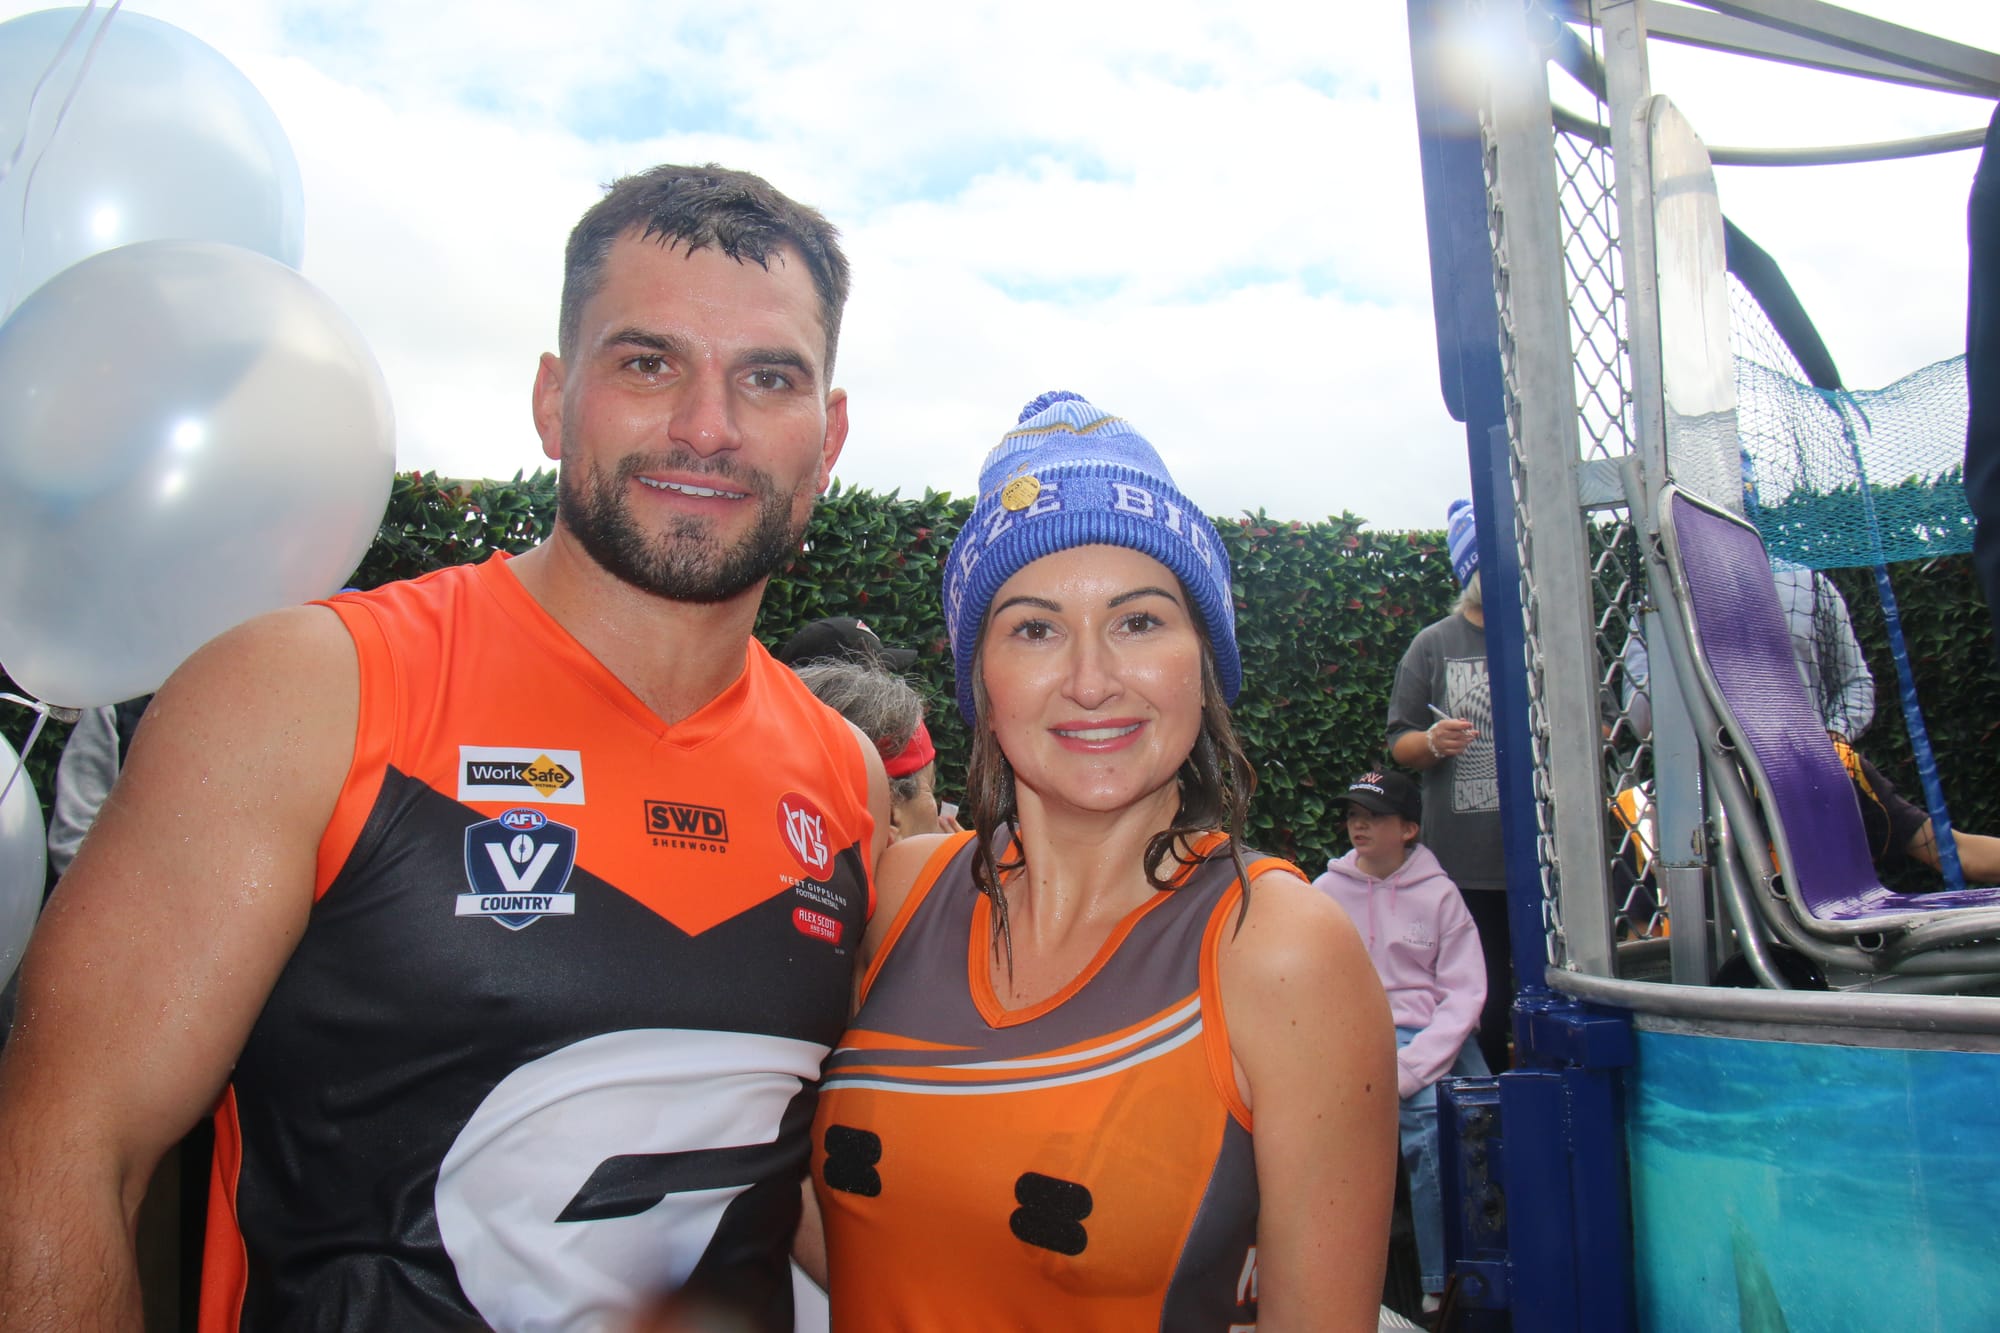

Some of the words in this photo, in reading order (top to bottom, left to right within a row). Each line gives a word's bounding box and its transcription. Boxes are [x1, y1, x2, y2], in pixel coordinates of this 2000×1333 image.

[1112, 481, 1212, 569] BIG
[1459, 552, 1479, 579] BIG
[504, 813, 543, 825] AFL
[651, 806, 723, 836] SWD
[653, 838, 726, 854] SHERWOOD
[780, 874, 805, 888] WEST
[808, 883, 847, 907] GIPPSLAND
[796, 888, 821, 903] FOOTBALL
[481, 896, 553, 911] COUNTRY
[799, 909, 817, 924] ALEX
[817, 915, 835, 931] SCOTT
[820, 927, 835, 939] STAFF
